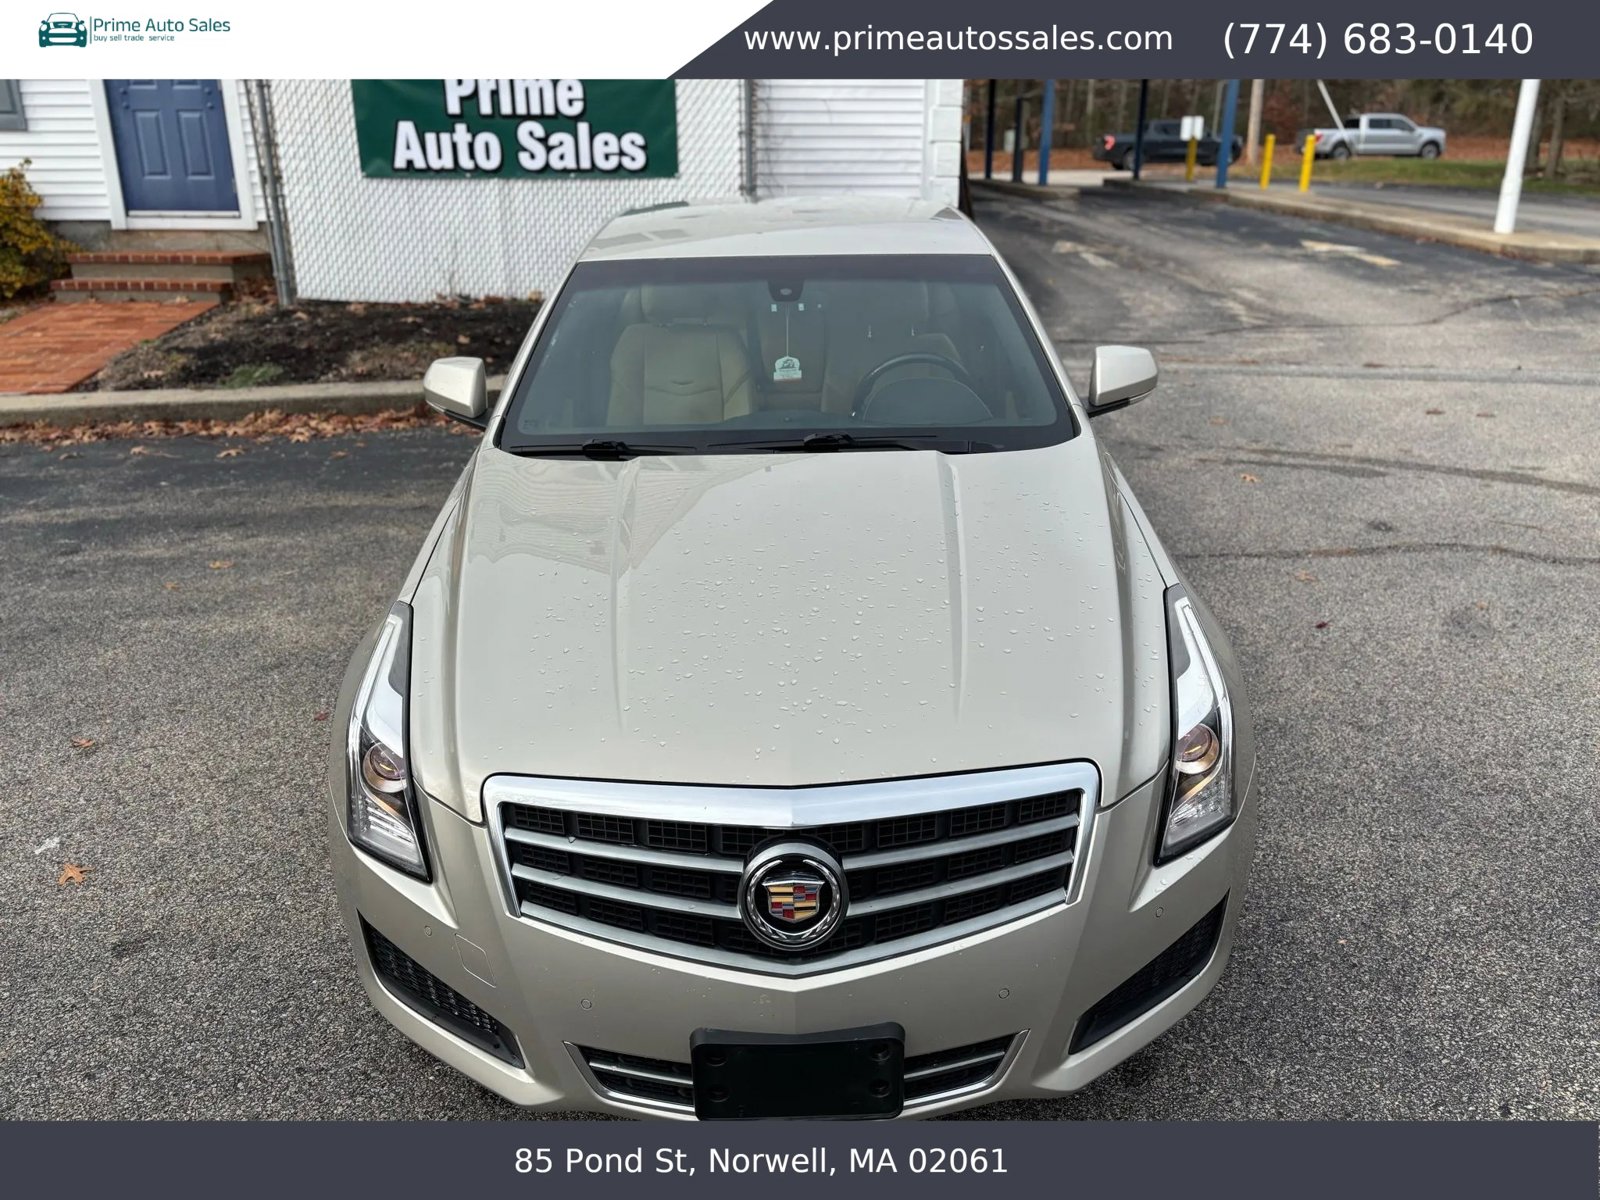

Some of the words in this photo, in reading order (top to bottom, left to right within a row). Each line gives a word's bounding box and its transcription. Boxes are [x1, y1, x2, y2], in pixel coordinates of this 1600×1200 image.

[444, 79, 584, 117] Prime
[393, 120, 502, 171] Auto
[516, 120, 647, 171] Sales
